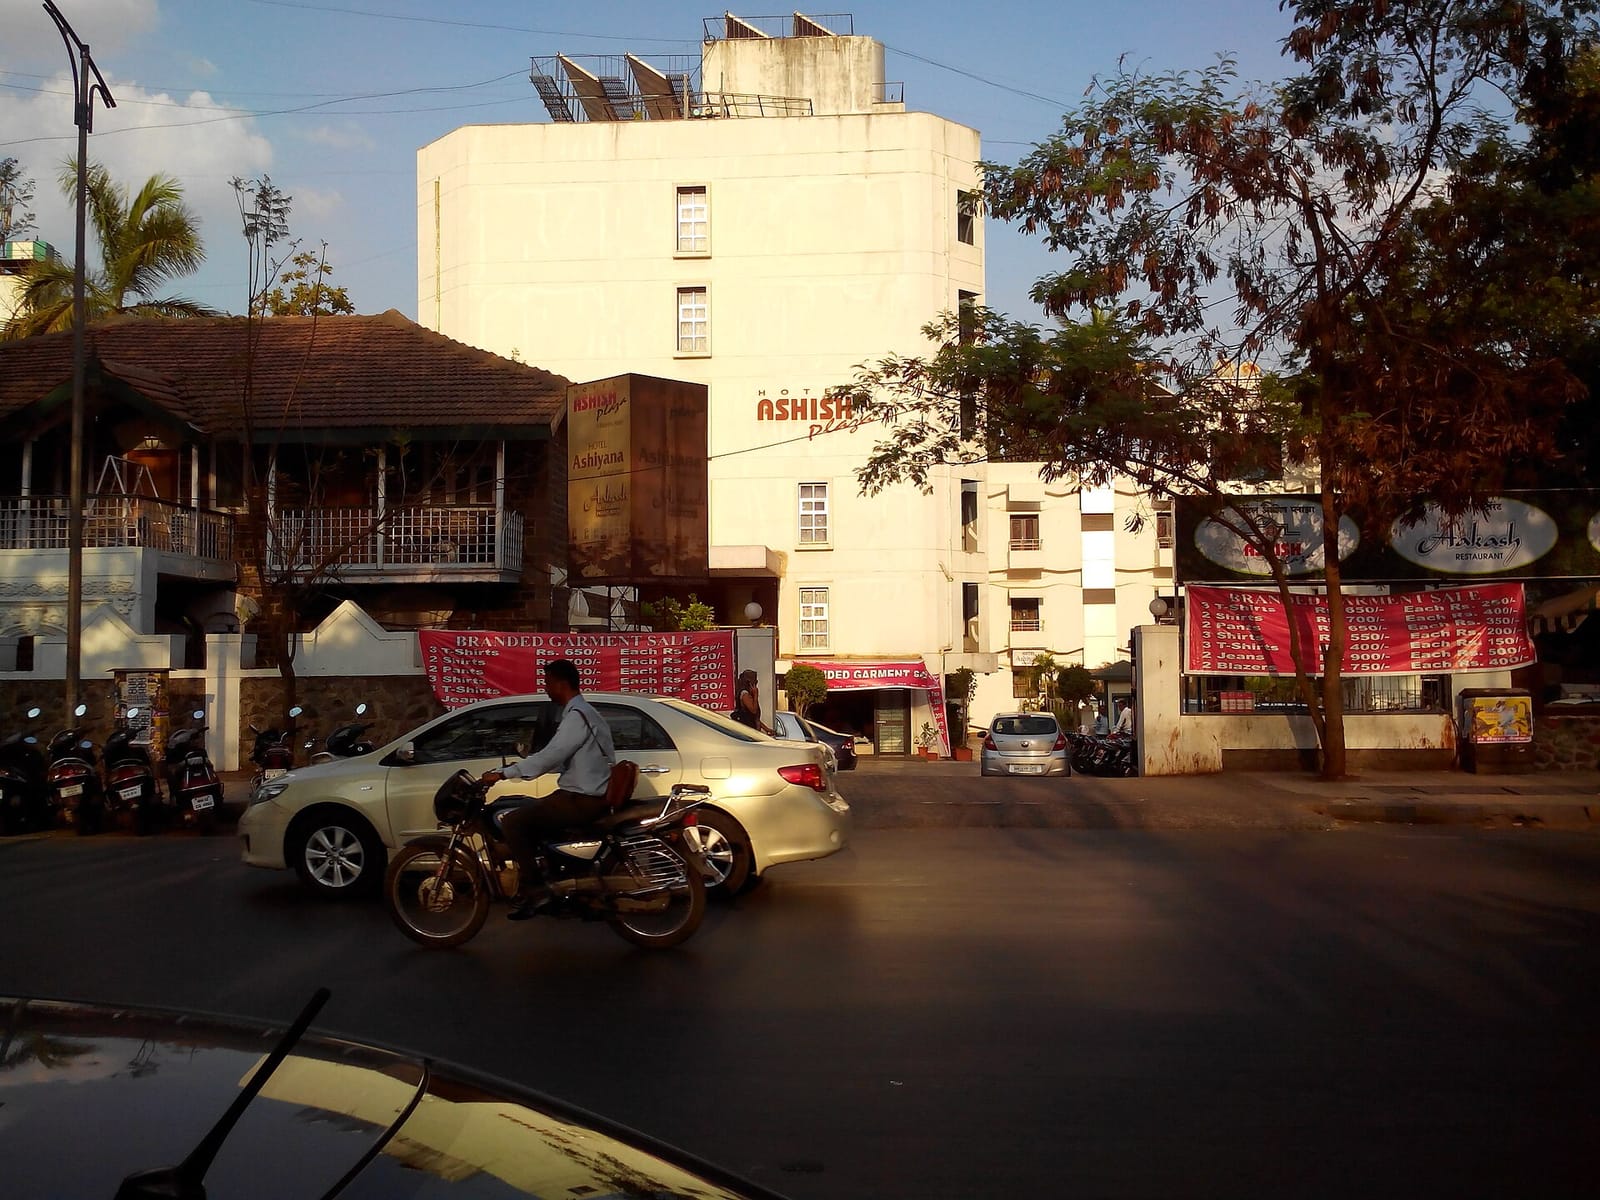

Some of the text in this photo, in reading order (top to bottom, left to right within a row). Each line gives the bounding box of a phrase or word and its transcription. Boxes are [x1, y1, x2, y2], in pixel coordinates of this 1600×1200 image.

[758, 388, 832, 396] HOTE
[757, 398, 852, 421] ASHISH
[573, 451, 624, 470] Ashiyana
[1418, 522, 1521, 566] Aakash
[1456, 553, 1503, 561] RESTAURANT
[1230, 593, 1320, 606] BRANED
[1327, 594, 1425, 606] ARMENT
[1214, 603, 1276, 613] T-Shirts
[1450, 603, 1475, 611] Rs.
[1216, 612, 1264, 621] Shirts
[1406, 614, 1446, 622] Each
[1483, 607, 1519, 615] 400/-
[1216, 622, 1261, 631] Pants
[1408, 622, 1450, 631] Each
[1217, 631, 1264, 641] Shirts
[1351, 633, 1391, 641] 550/-
[1411, 630, 1450, 639] Each
[1487, 627, 1522, 635] 200/-
[456, 635, 694, 648] BRANDED GARMENT SALE
[1216, 641, 1279, 651] T-Shirts
[1410, 640, 1451, 648] Each
[1488, 637, 1523, 645] 150/-
[441, 648, 500, 656] T-Shirts
[565, 648, 601, 656] 650/-
[1217, 652, 1265, 661] Jeans
[1411, 650, 1451, 659] Each
[1488, 646, 1527, 656] 500/-
[429, 655, 438, 663] 2
[442, 656, 486, 666] Shirts
[1217, 662, 1277, 671] Blazers
[1411, 661, 1451, 669] Each
[1458, 659, 1484, 667] Rs.
[1489, 655, 1529, 666] 400/-
[429, 665, 438, 673] 2
[442, 666, 484, 675] Pants
[853, 668, 910, 680] GARMENT
[429, 674, 438, 682] 3
[442, 675, 486, 685] Shirts
[691, 672, 727, 681] 200/-
[441, 685, 500, 695] T-Shirts
[691, 682, 727, 690] 150/-
[691, 692, 728, 700] 500/-
[696, 702, 728, 710] 00/-
